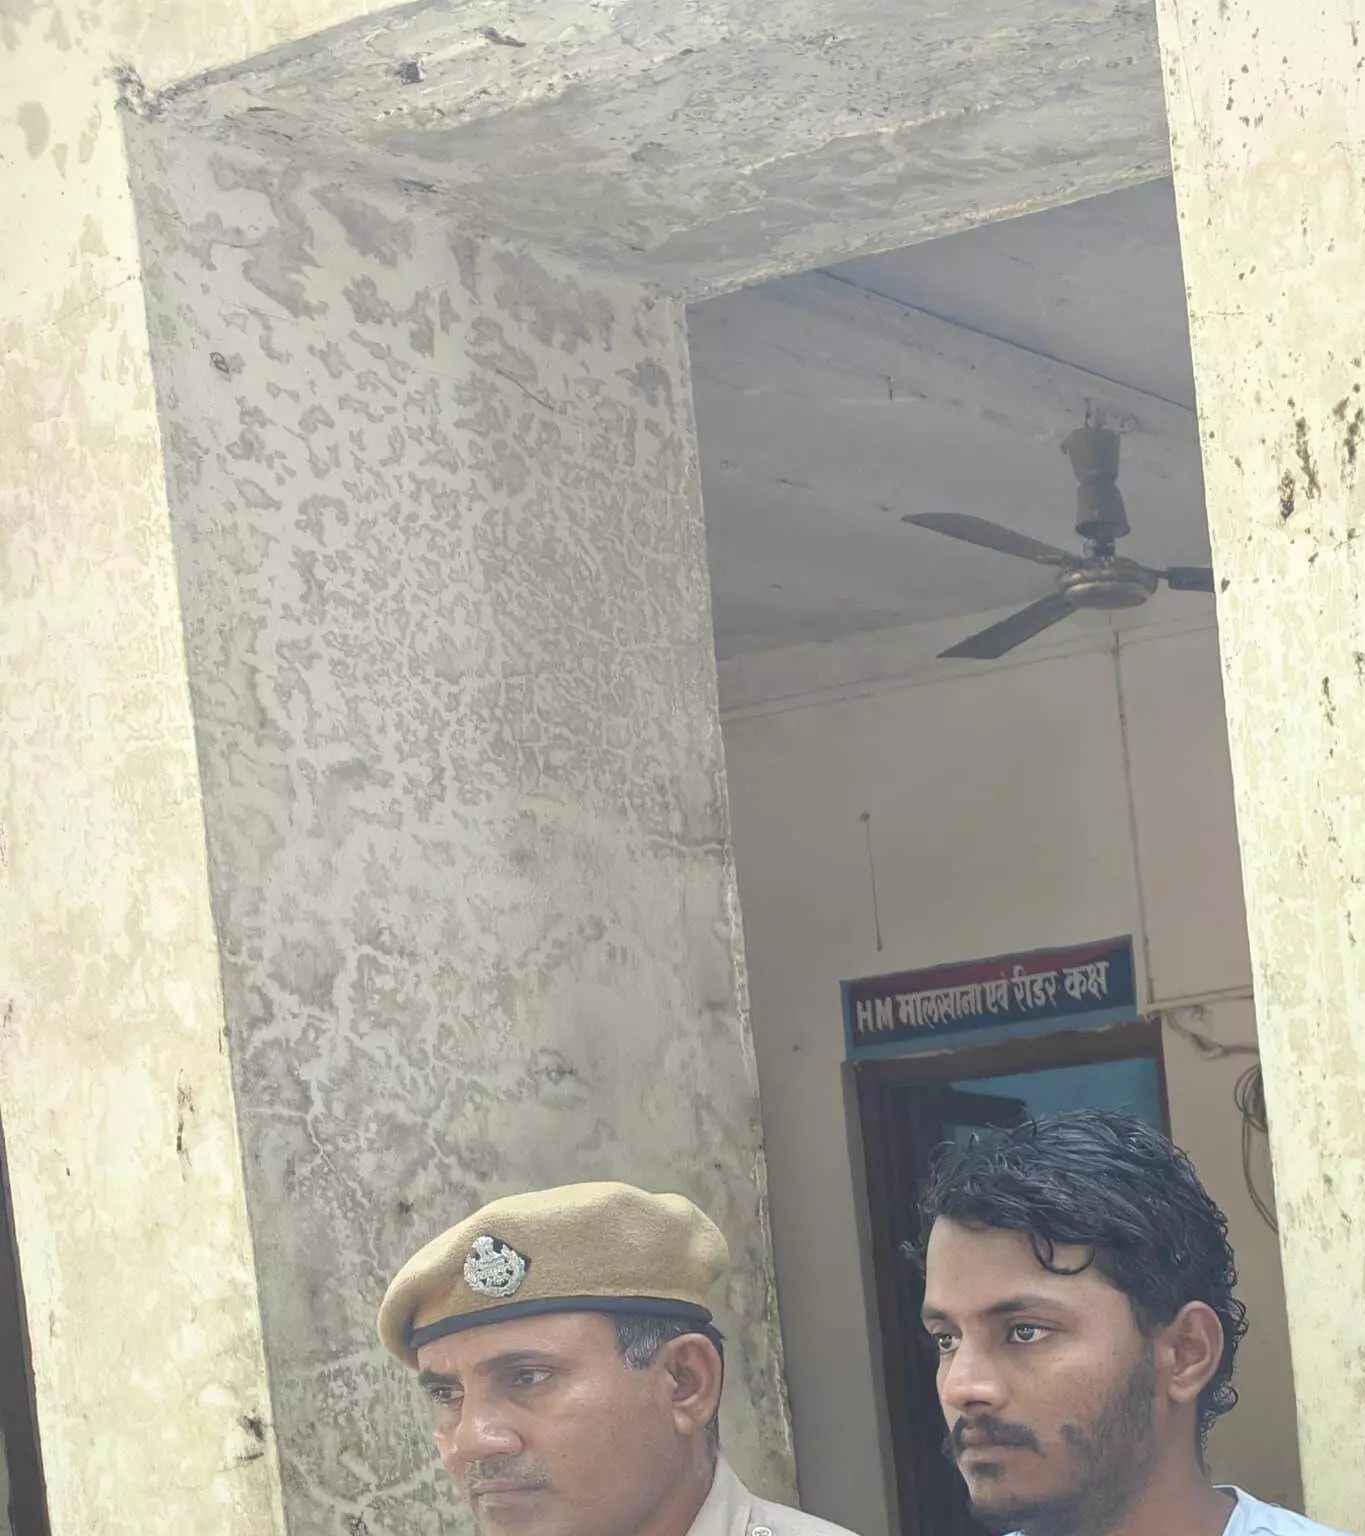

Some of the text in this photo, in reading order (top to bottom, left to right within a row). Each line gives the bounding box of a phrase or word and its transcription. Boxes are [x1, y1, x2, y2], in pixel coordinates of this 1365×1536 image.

[983, 972, 1009, 1015] एवं
[1011, 964, 1058, 1012] रीडर
[1062, 961, 1110, 1001] कक्ष
